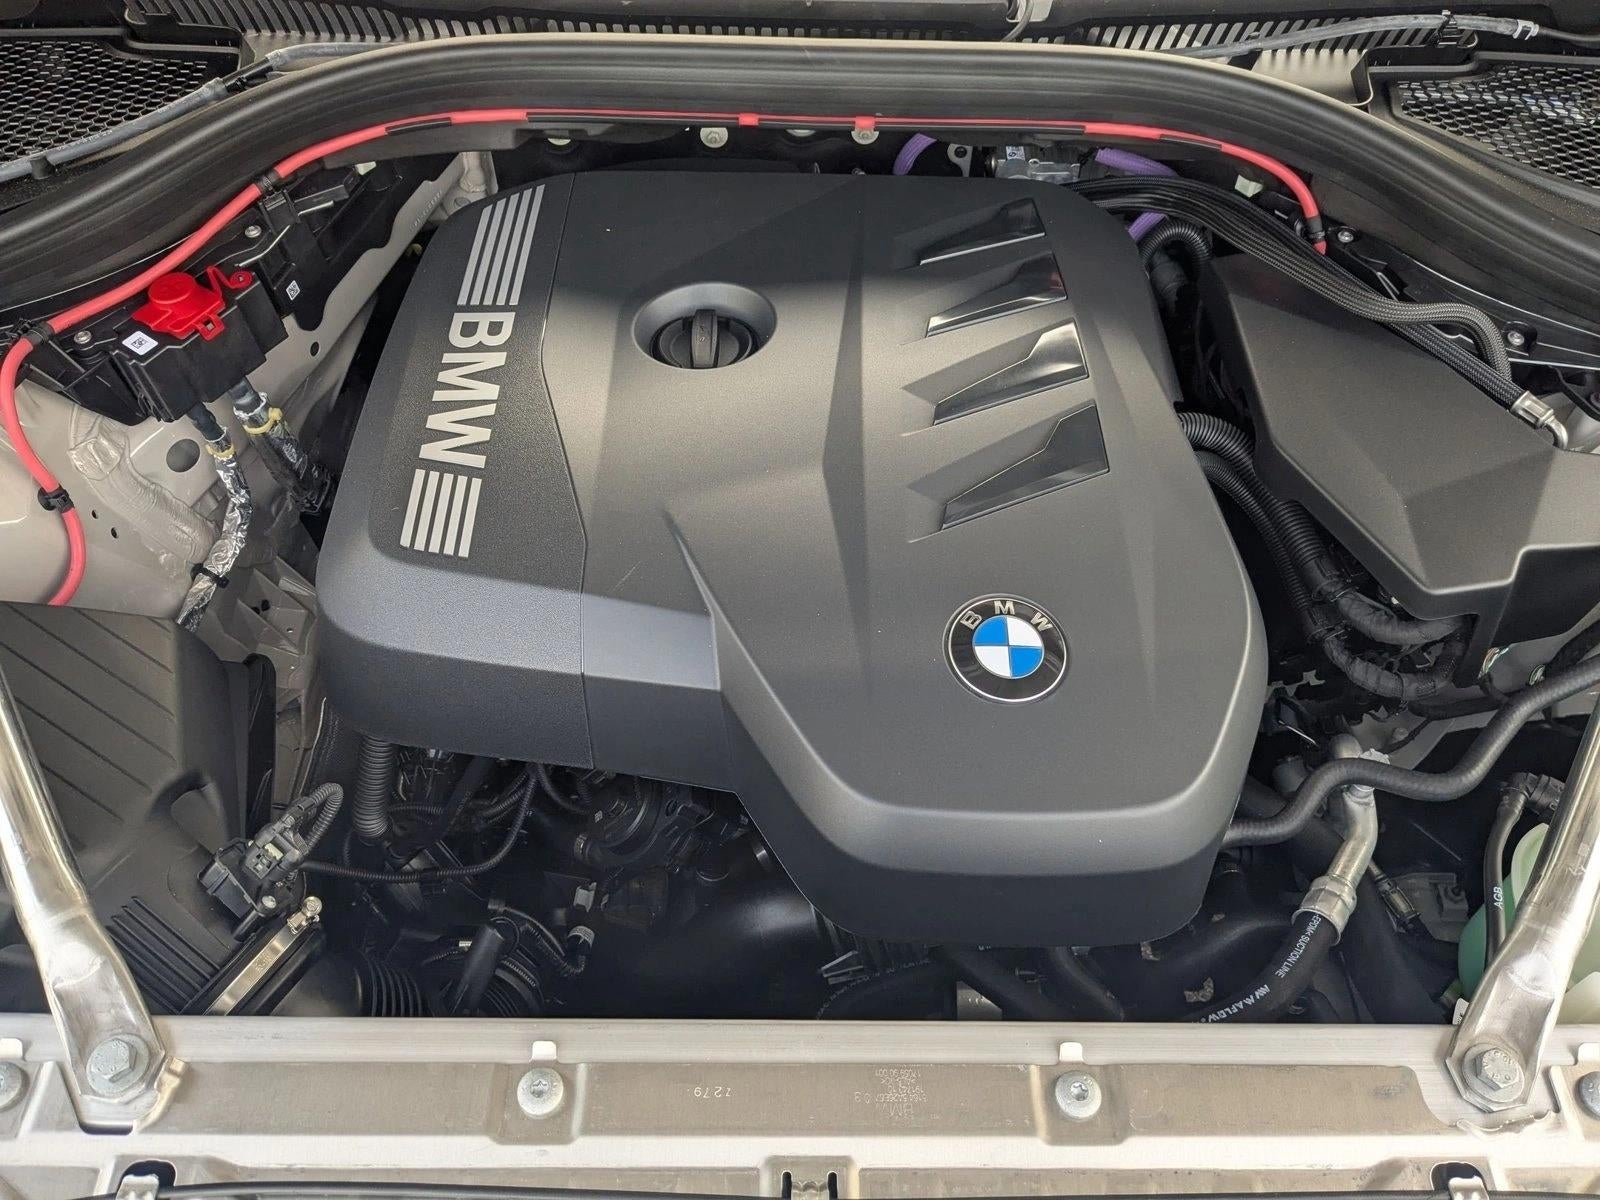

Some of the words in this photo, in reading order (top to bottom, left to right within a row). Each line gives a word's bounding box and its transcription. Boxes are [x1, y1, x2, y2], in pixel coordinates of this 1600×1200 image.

[418, 311, 516, 470] BMW
[960, 600, 1054, 633] BMW
[1492, 886, 1506, 911] AGB
[1288, 935, 1310, 964] SUCTION
[1275, 961, 1294, 978] LINE
